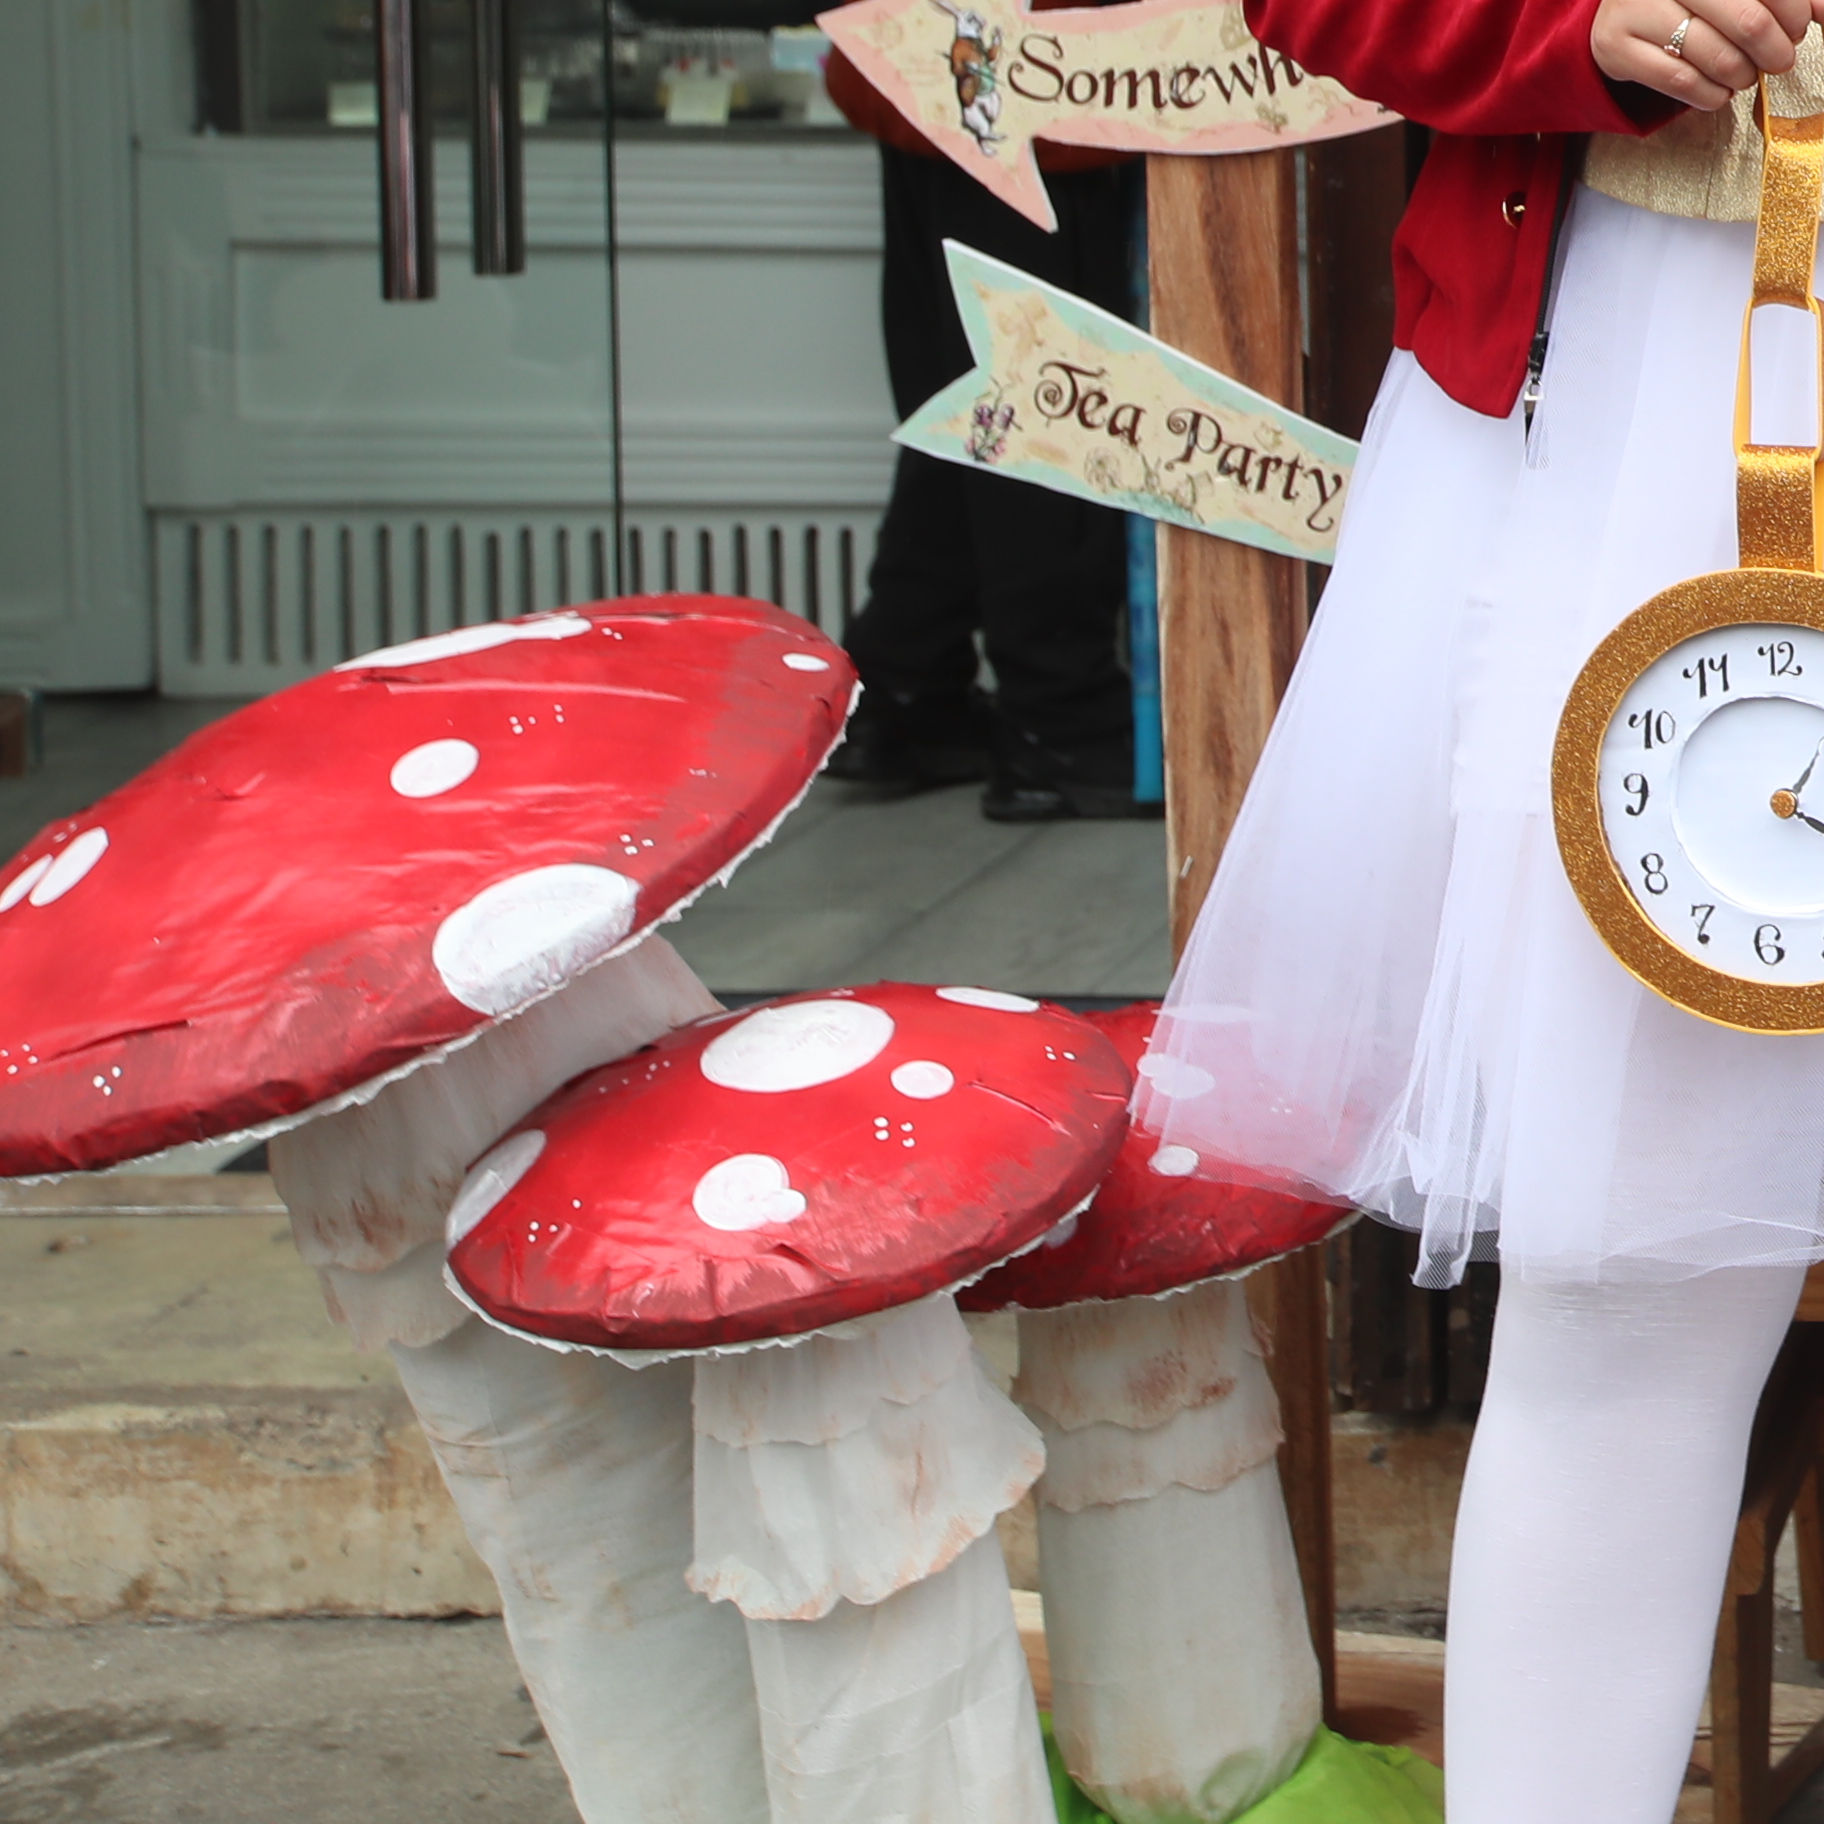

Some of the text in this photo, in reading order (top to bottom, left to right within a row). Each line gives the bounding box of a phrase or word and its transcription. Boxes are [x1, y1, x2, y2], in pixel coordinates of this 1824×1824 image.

[1008, 35, 1304, 110] Somewh
[1034, 362, 1342, 532] Tea Party
[1683, 653, 1729, 698] 11
[1758, 641, 1802, 676] 12
[1628, 708, 1676, 749] 10
[1623, 773, 1649, 816] 9
[1641, 853, 1668, 894] 8
[1690, 904, 1716, 944] 7
[1754, 924, 1785, 964] 6
